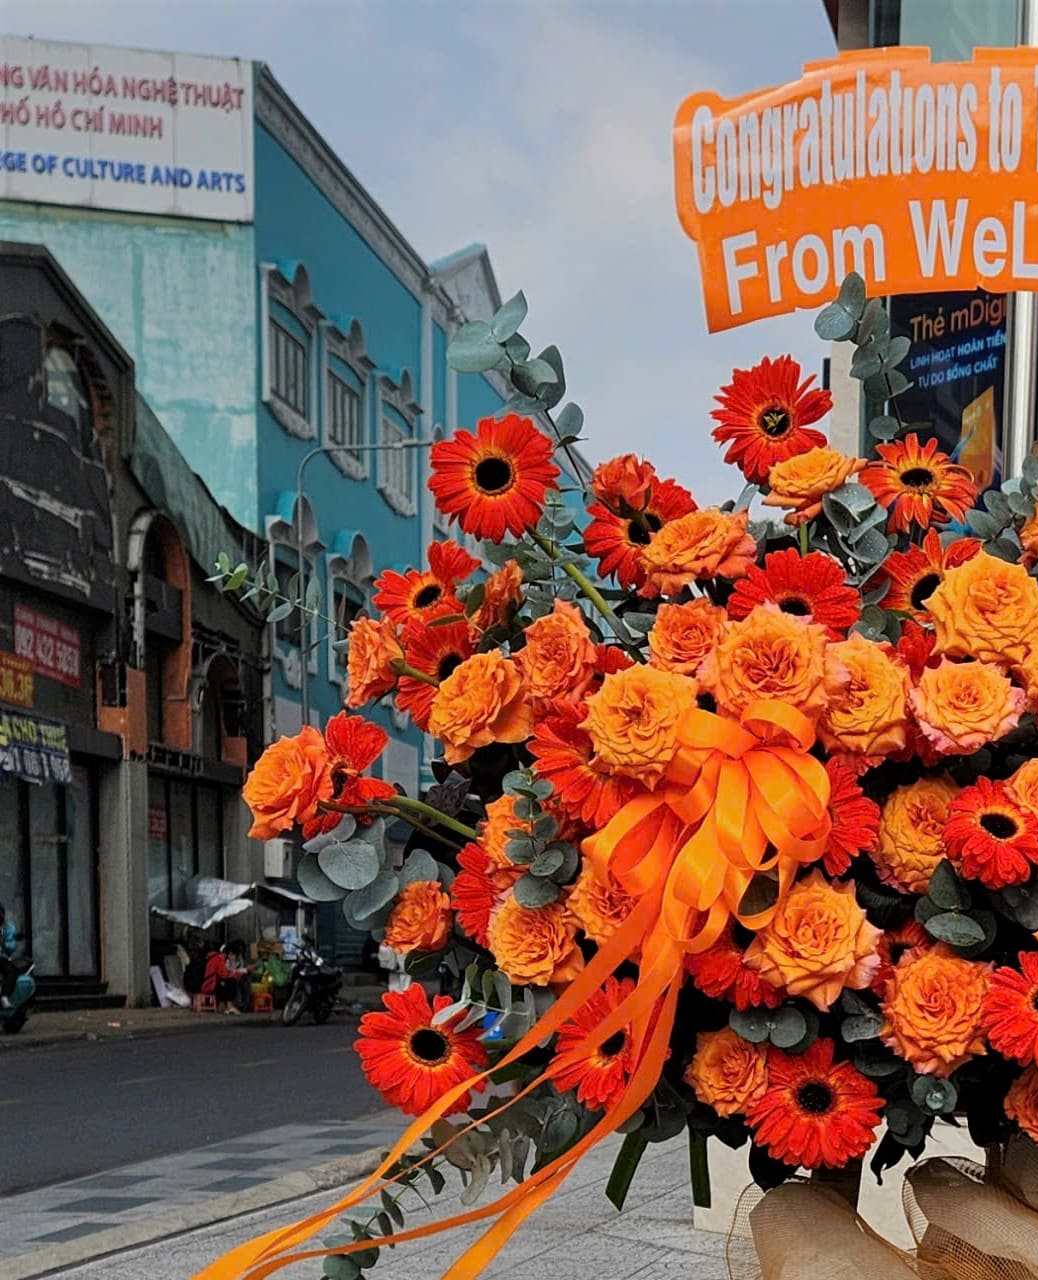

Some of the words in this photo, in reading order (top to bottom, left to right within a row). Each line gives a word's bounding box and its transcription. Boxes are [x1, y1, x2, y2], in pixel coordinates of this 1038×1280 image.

[70, 105, 104, 135] CHÍ
[108, 111, 163, 140] MINH
[691, 69, 977, 215] Congratulations
[988, 65, 1023, 173] to
[0, 151, 27, 173] GE
[31, 153, 58, 176] OF
[62, 156, 147, 185] CULTURE
[149, 164, 193, 190] AND
[196, 169, 247, 194] ARTS
[721, 222, 886, 316] From
[910, 307, 946, 343] Thẻ
